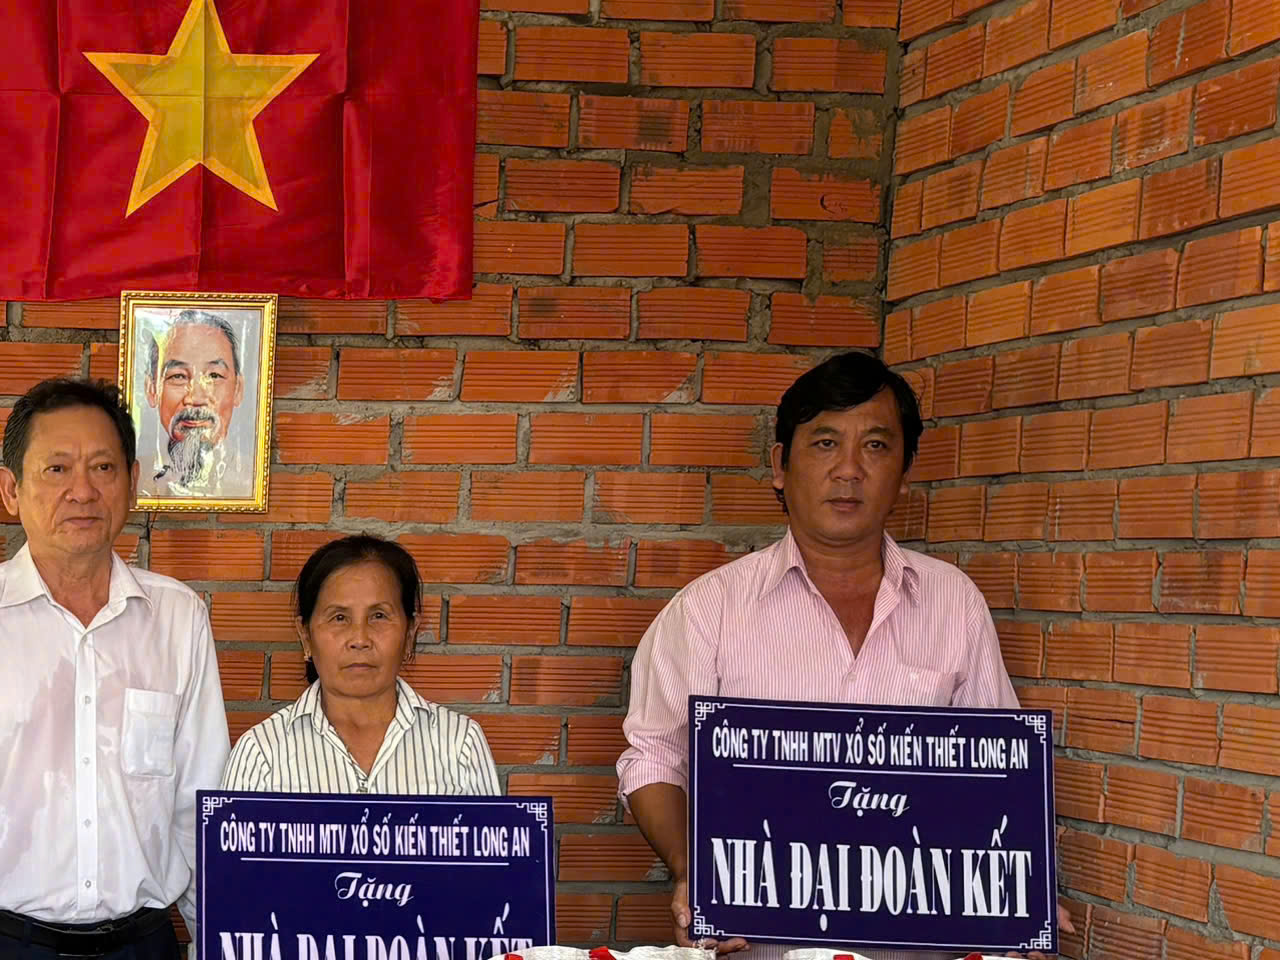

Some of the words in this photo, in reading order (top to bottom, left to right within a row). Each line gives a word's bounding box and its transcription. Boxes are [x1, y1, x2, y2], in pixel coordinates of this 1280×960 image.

[712, 720, 748, 759] CÔNG
[751, 729, 768, 759] TY
[772, 730, 808, 761] TNHH
[813, 732, 841, 763] MTV
[845, 718, 862, 764] XỔ
[868, 723, 886, 765] SỐ
[891, 723, 921, 767] KIẾN
[926, 725, 965, 768] THIẾT
[971, 737, 1006, 769] LONG
[1010, 739, 1028, 769] AN
[828, 781, 910, 817] Tặng
[221, 814, 255, 851] CÔNG
[259, 823, 275, 852] TY
[279, 824, 314, 853] TNHH
[320, 824, 347, 854] MTV
[351, 808, 368, 855] XỔ
[373, 813, 392, 855] SỐ
[396, 813, 426, 856] KIẾN
[431, 815, 468, 857] THIẾT
[474, 827, 508, 857] LONG
[512, 827, 529, 857] AN
[335, 872, 414, 907] Tặng
[712, 820, 779, 907] NHÀ
[789, 842, 851, 931] ĐẠI
[860, 826, 951, 915] ĐOÀN
[961, 815, 1032, 918] KẾT
